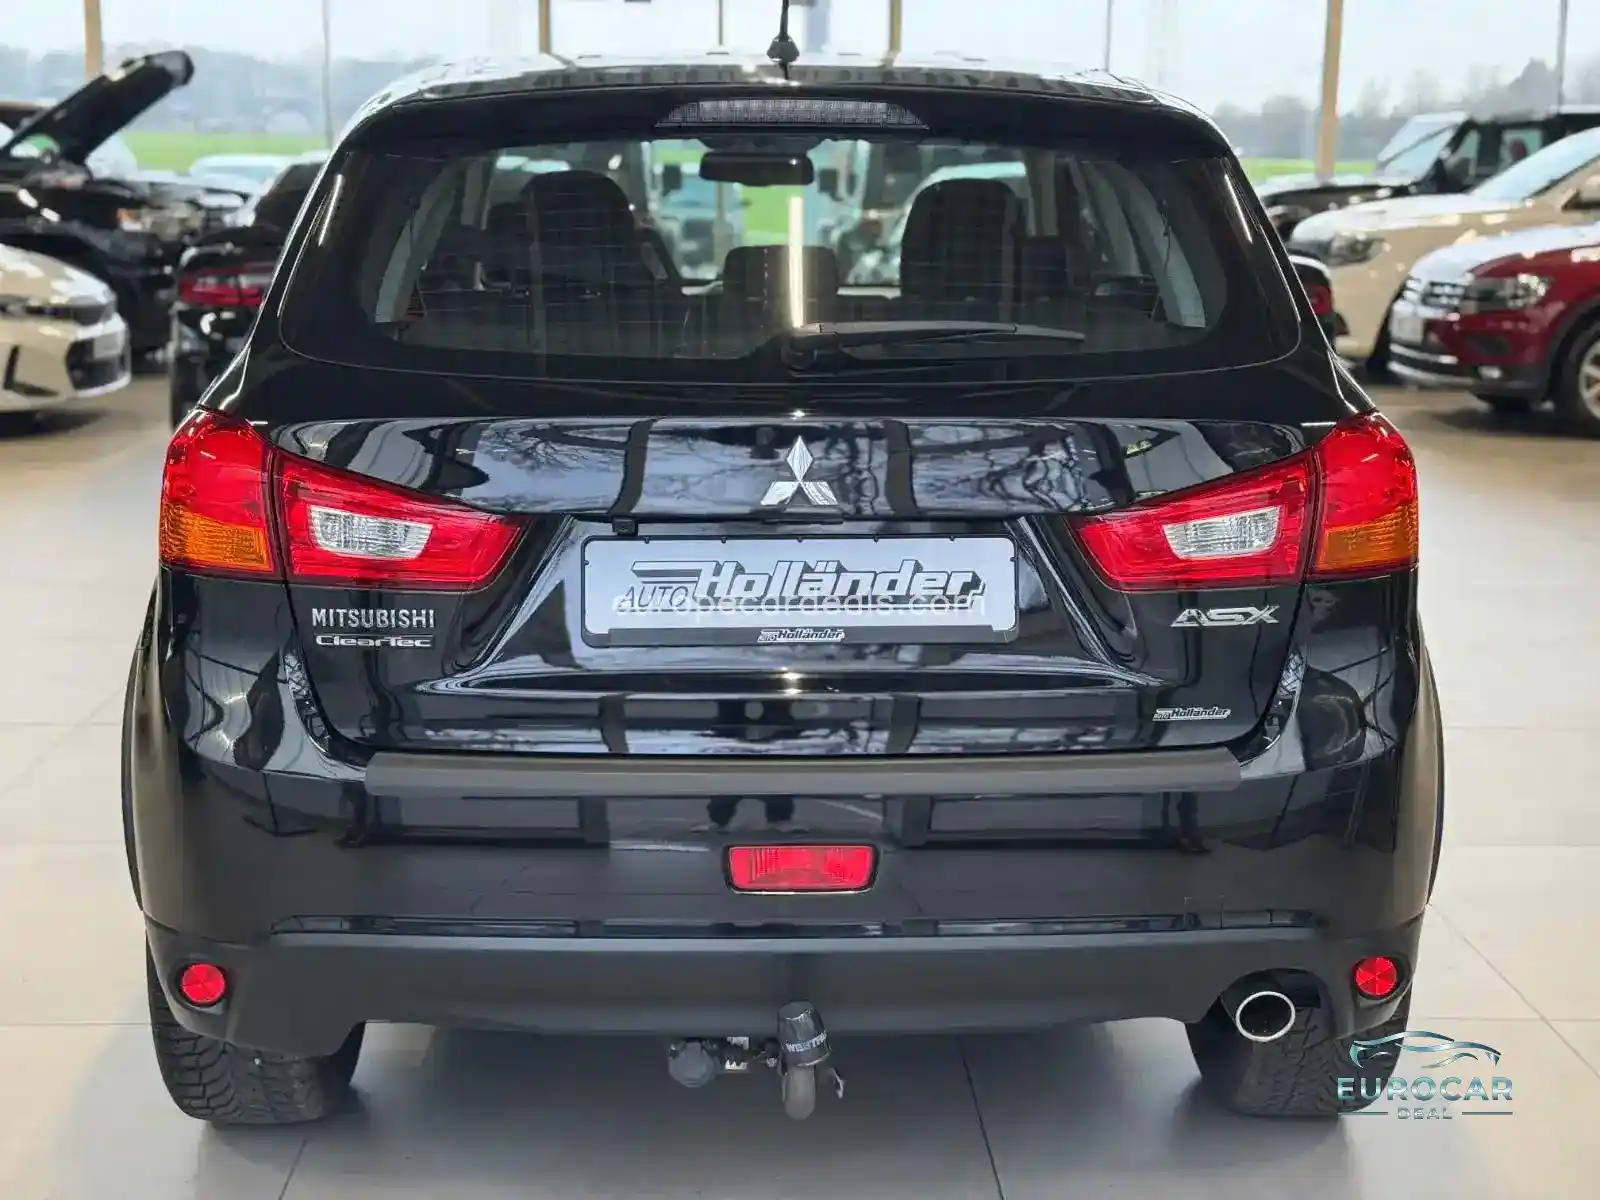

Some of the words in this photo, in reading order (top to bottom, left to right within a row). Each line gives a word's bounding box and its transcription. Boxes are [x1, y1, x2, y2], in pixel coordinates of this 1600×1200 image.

[618, 585, 690, 608] AUTO
[693, 560, 985, 612] Holländer
[312, 608, 434, 628] MITSUBISHI
[1170, 605, 1280, 627] ASX
[316, 635, 431, 647] ClearTec
[776, 628, 845, 641] Holländer
[1169, 705, 1231, 719] Holländer
